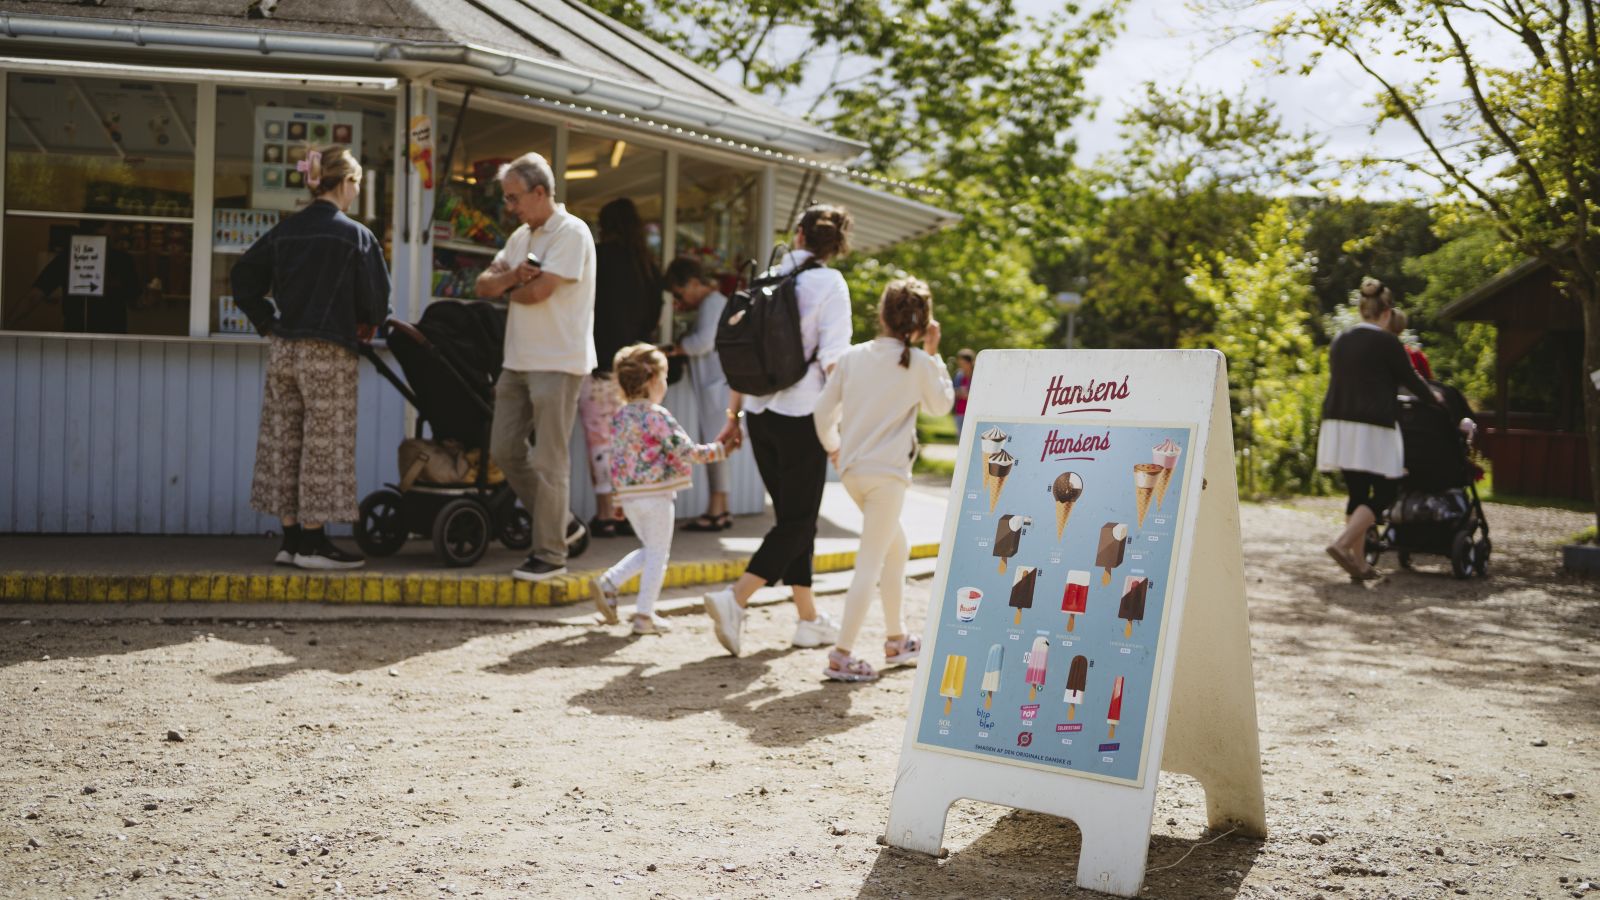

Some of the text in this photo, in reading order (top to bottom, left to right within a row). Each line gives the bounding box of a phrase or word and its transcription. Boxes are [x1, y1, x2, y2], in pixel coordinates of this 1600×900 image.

[1041, 375, 1130, 416] Hansens
[1040, 429, 1111, 462] Hansens
[976, 708, 991, 721] blip
[1022, 710, 1036, 719] POP
[979, 718, 995, 731] blop
[975, 744, 996, 753] SMAGEN
[1015, 751, 1044, 761] ORIGINALE
[1044, 756, 1066, 765] DANSKE
